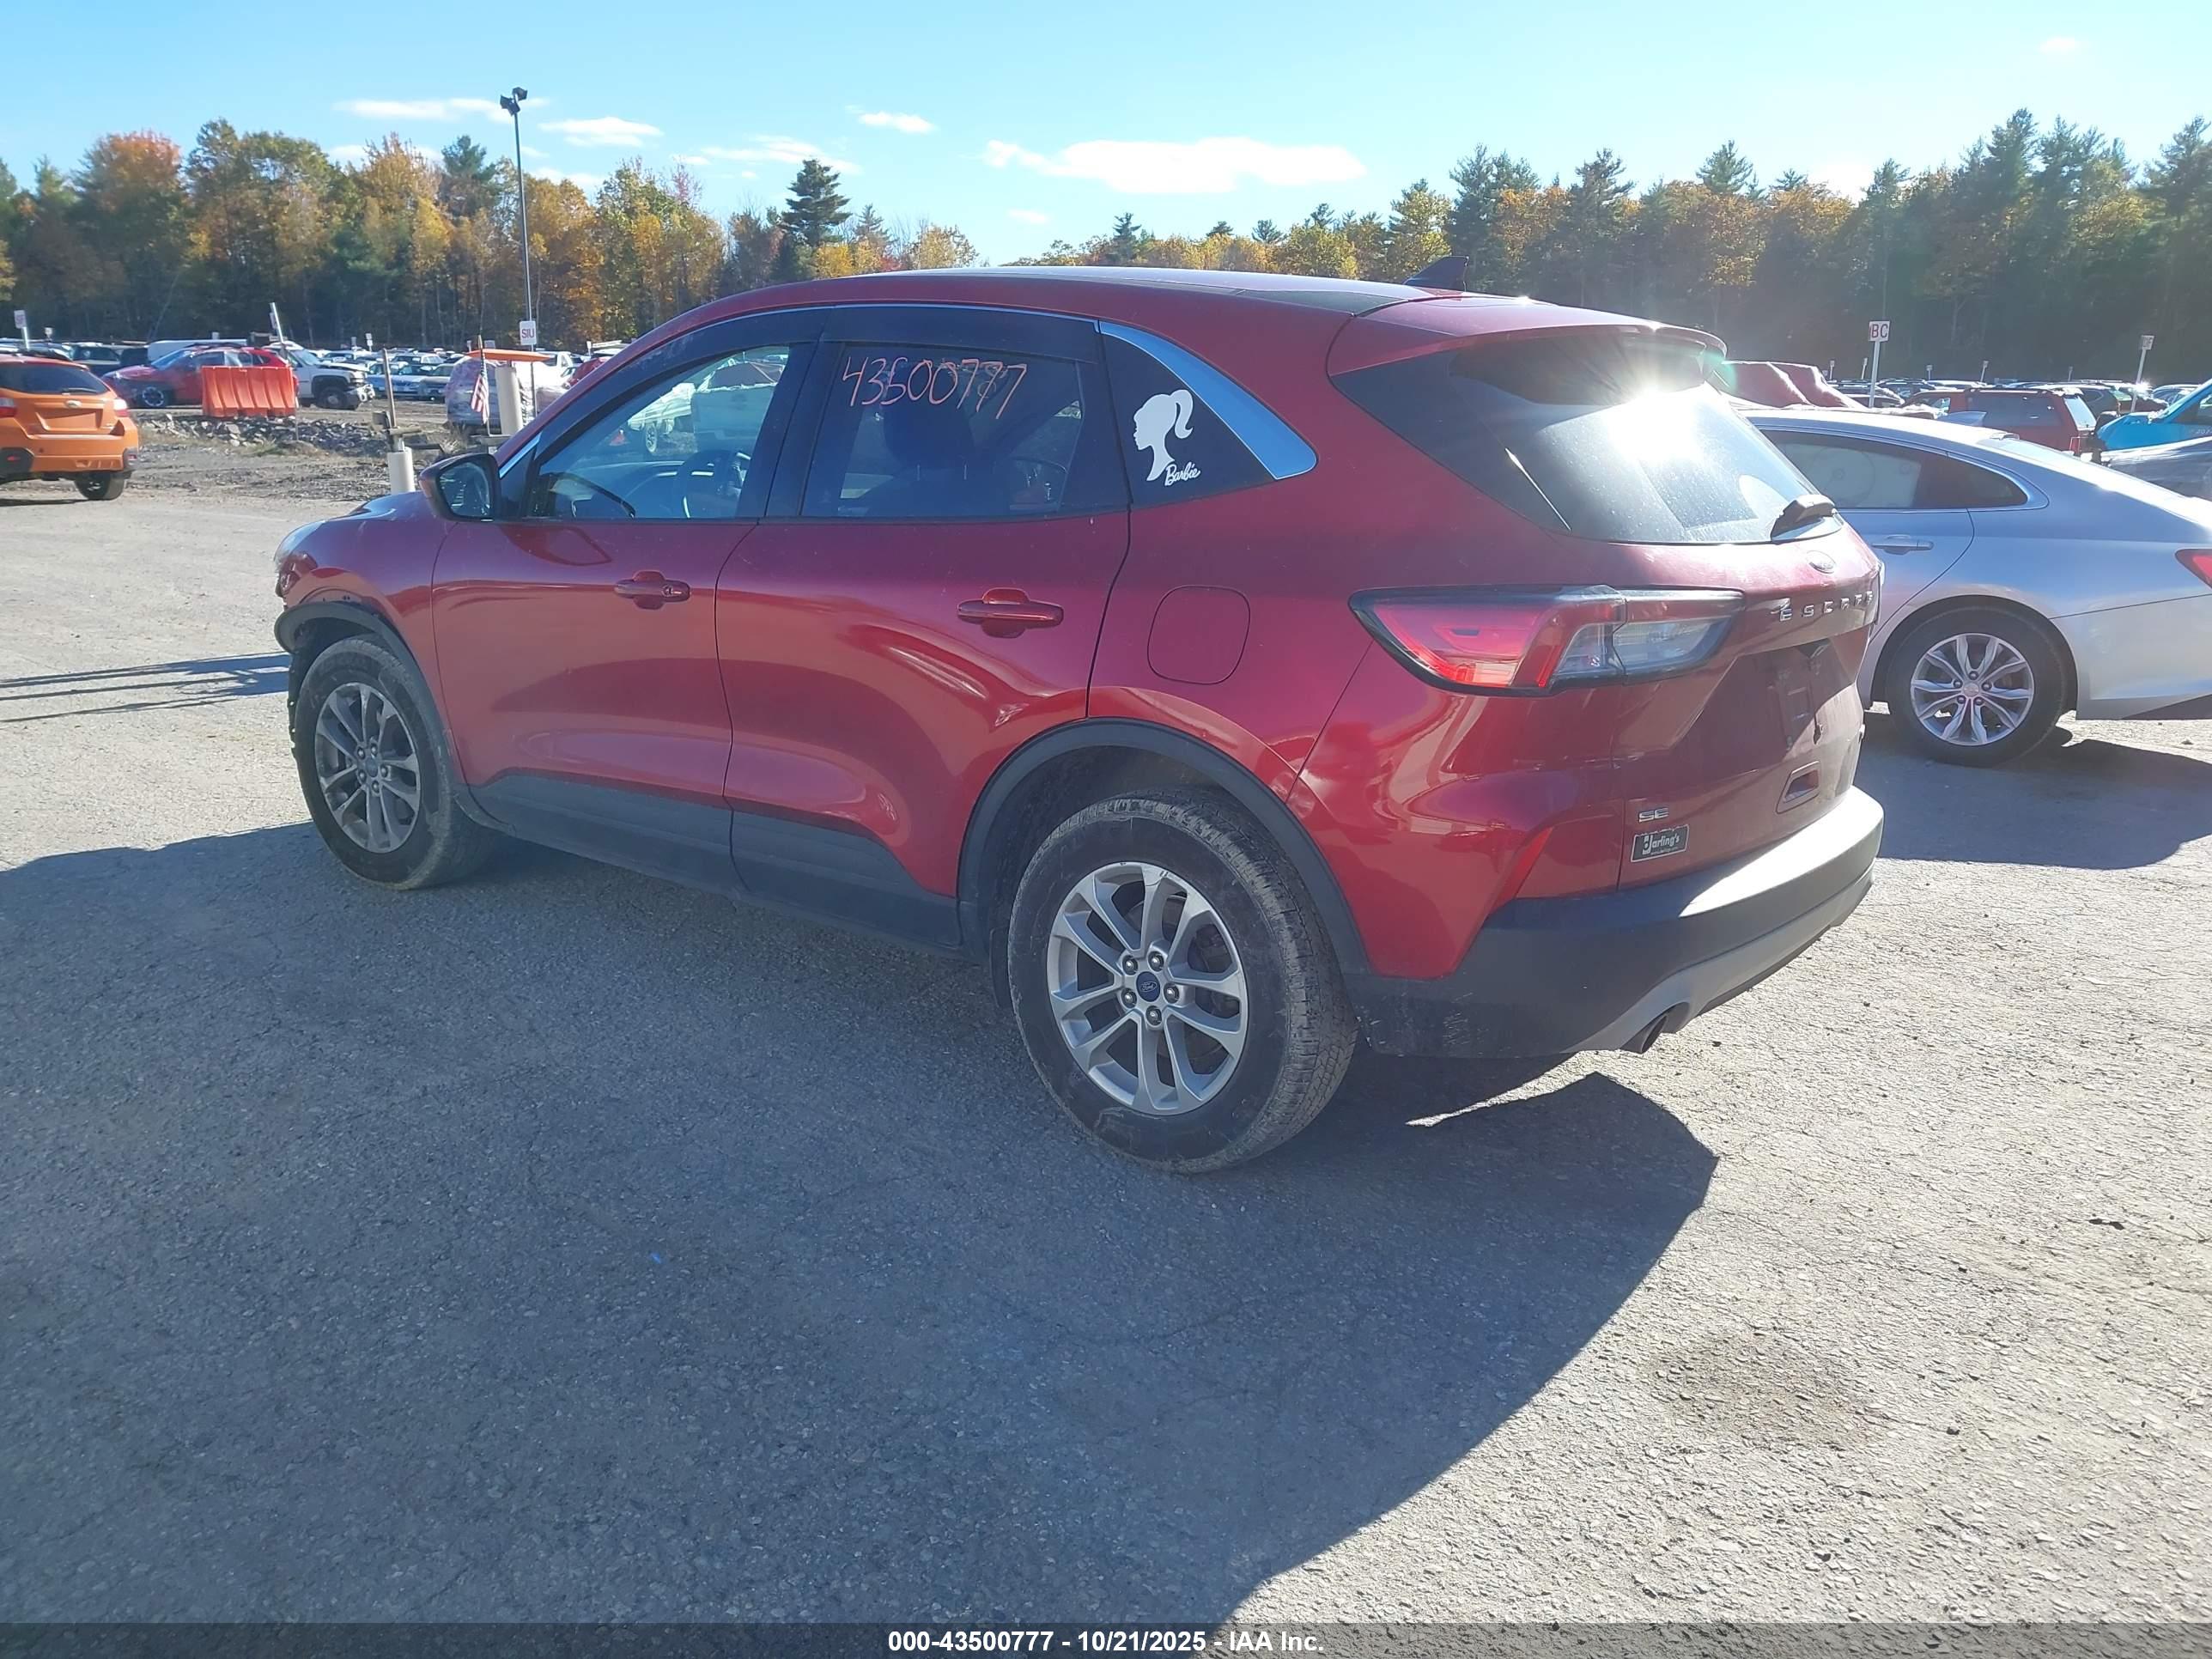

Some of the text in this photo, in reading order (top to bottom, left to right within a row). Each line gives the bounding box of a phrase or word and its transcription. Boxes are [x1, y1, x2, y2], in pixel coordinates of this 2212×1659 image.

[521, 328, 535, 338] SIU
[1872, 323, 1888, 338] BC
[1164, 461, 1201, 486] Barbie
[1638, 807, 1669, 823] SE
